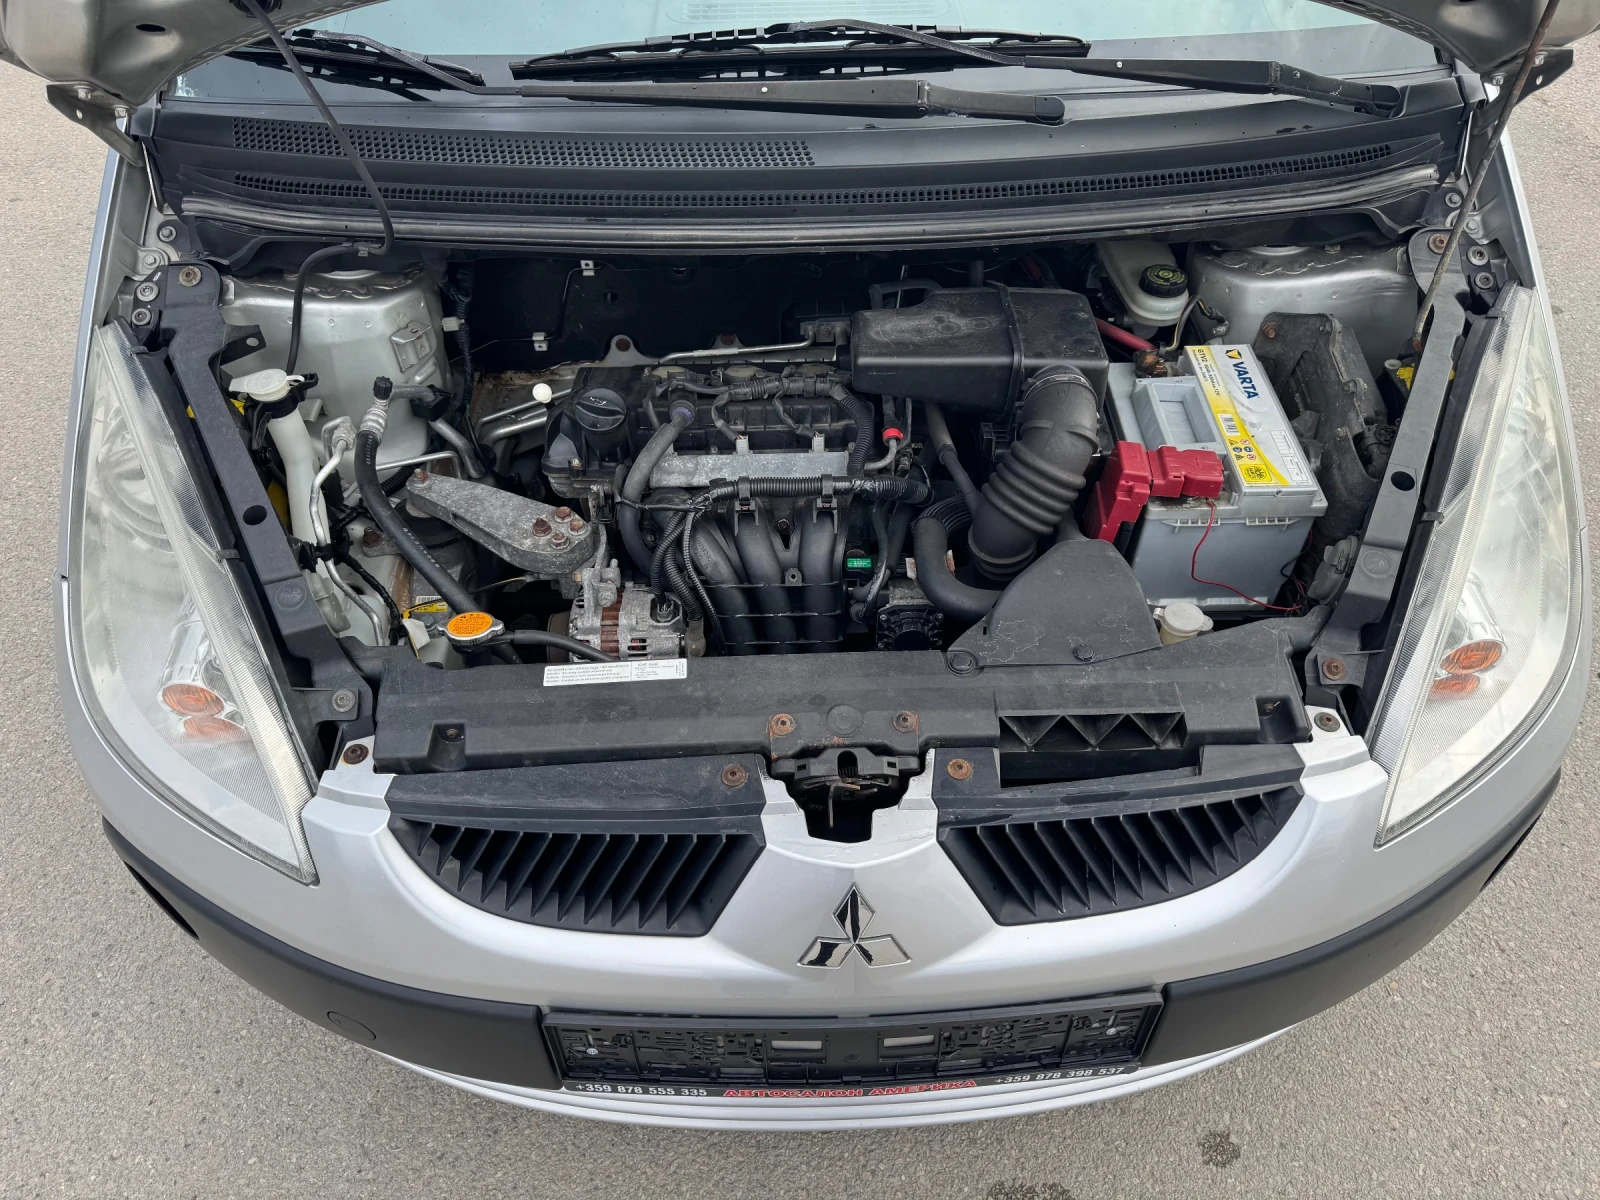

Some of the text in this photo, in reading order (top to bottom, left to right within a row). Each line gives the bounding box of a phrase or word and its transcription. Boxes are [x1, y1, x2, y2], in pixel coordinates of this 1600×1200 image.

[1232, 361, 1259, 399] VARTA
[995, 1067, 1125, 1084] +359 878 398 537
[576, 1083, 708, 1096] +359 878 555 335
[723, 1080, 977, 1098] АВТОСАЛОН АМЕРИКА
